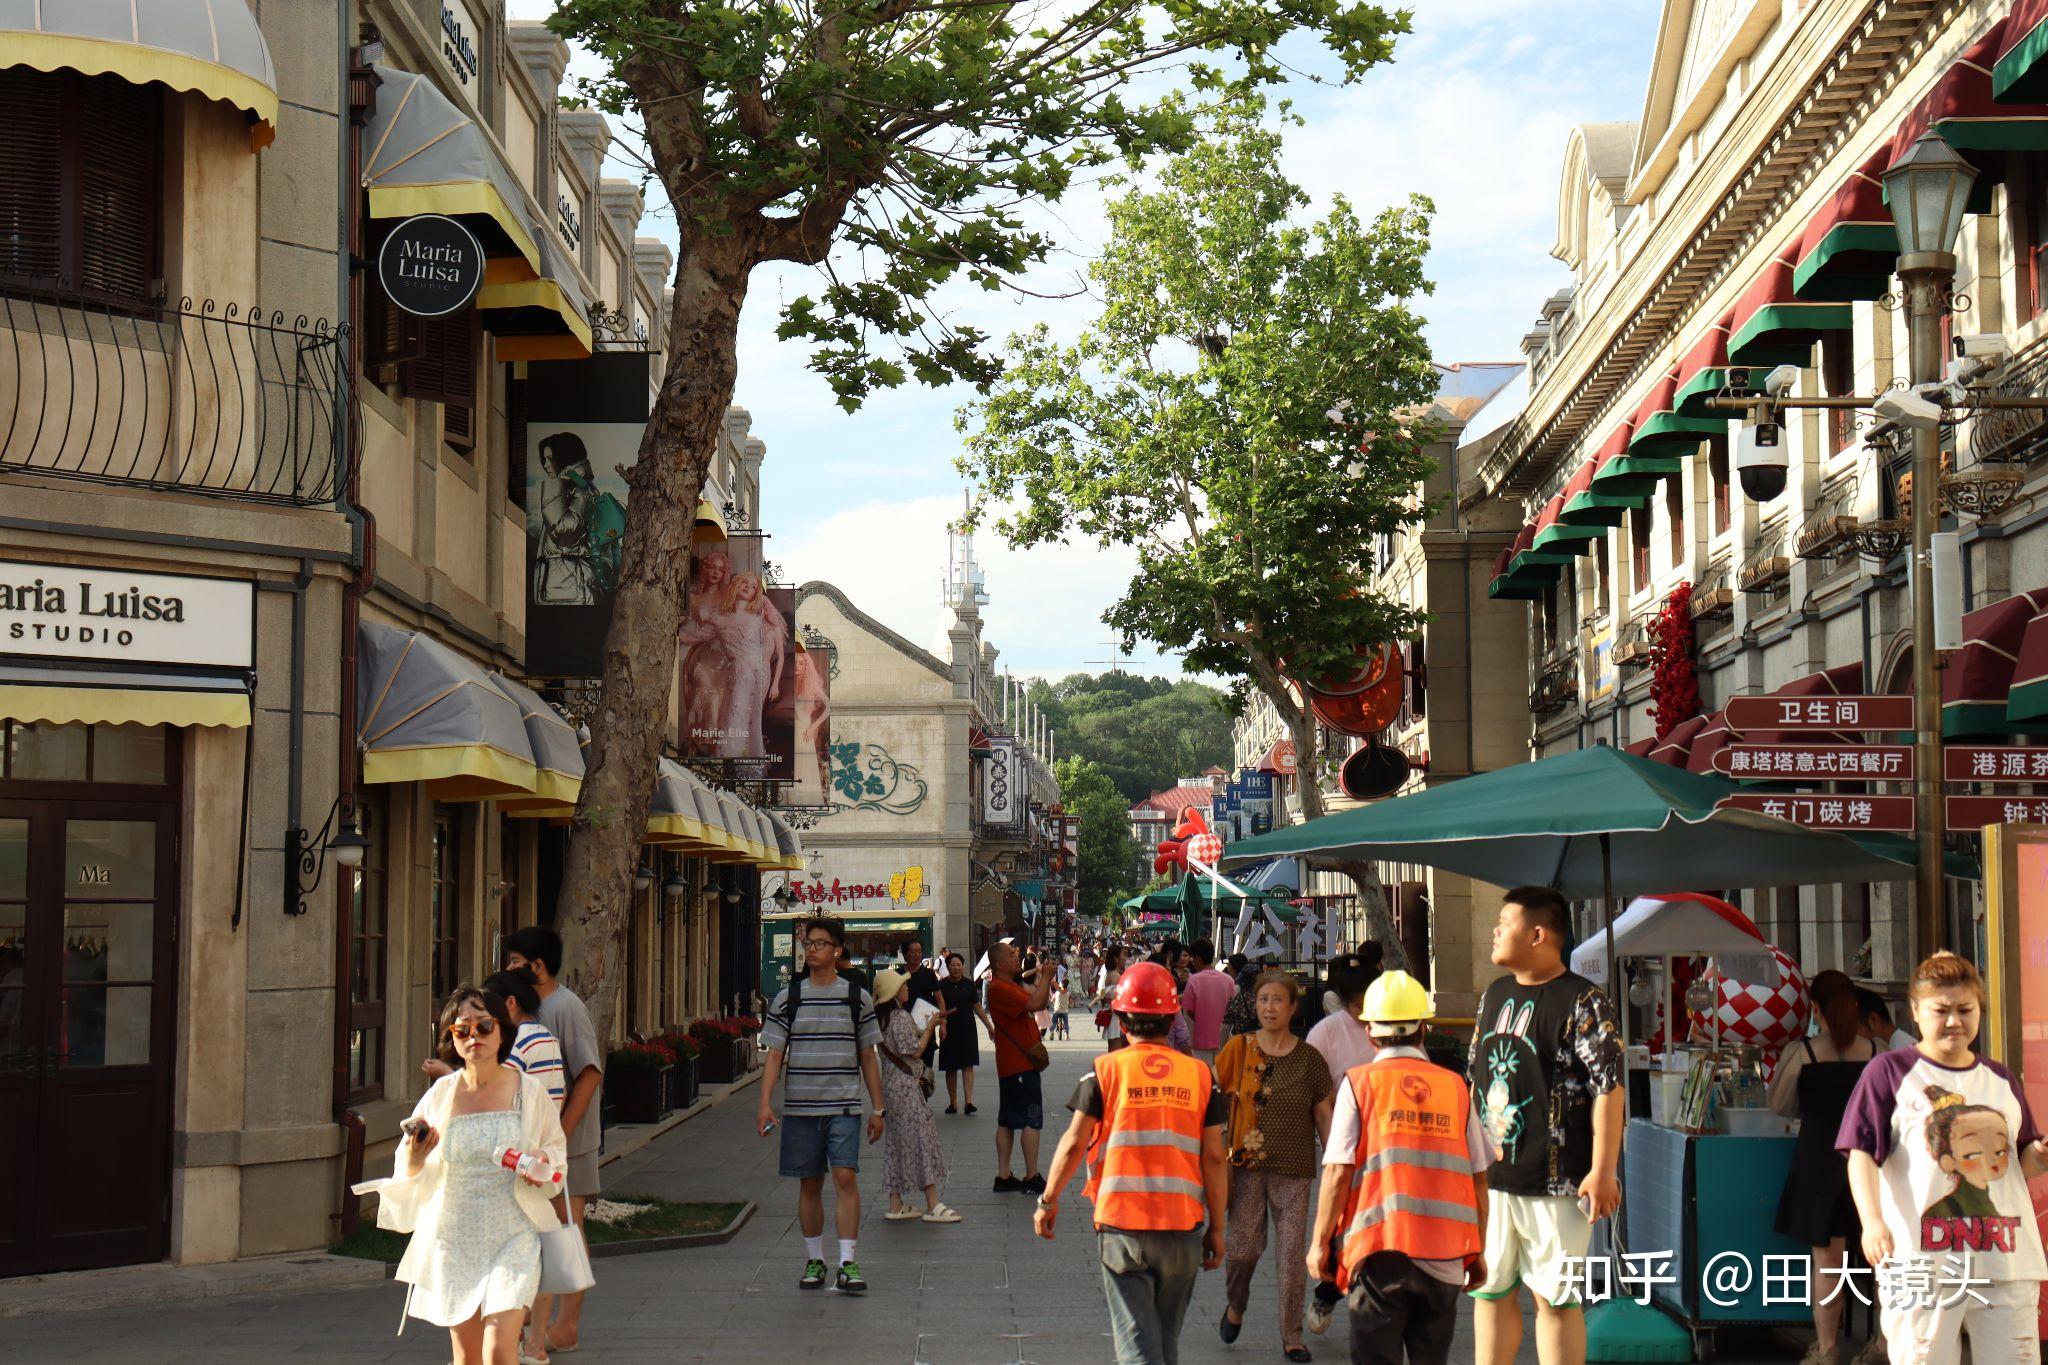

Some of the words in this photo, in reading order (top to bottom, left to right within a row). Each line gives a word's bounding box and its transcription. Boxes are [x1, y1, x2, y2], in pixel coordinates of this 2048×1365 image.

[400, 240, 462, 263] Maria
[399, 259, 460, 282] Luisa
[79, 583, 185, 623] Luisa
[10, 623, 133, 646] STUDIO
[1779, 701, 1858, 725] 卫生间
[692, 728, 725, 738] Marie
[1730, 751, 1903, 773] 康塔塔意式西餐厅
[1762, 800, 1872, 825] 东门碳烤
[78, 865, 111, 884] Ma
[1233, 903, 1346, 961] 公社
